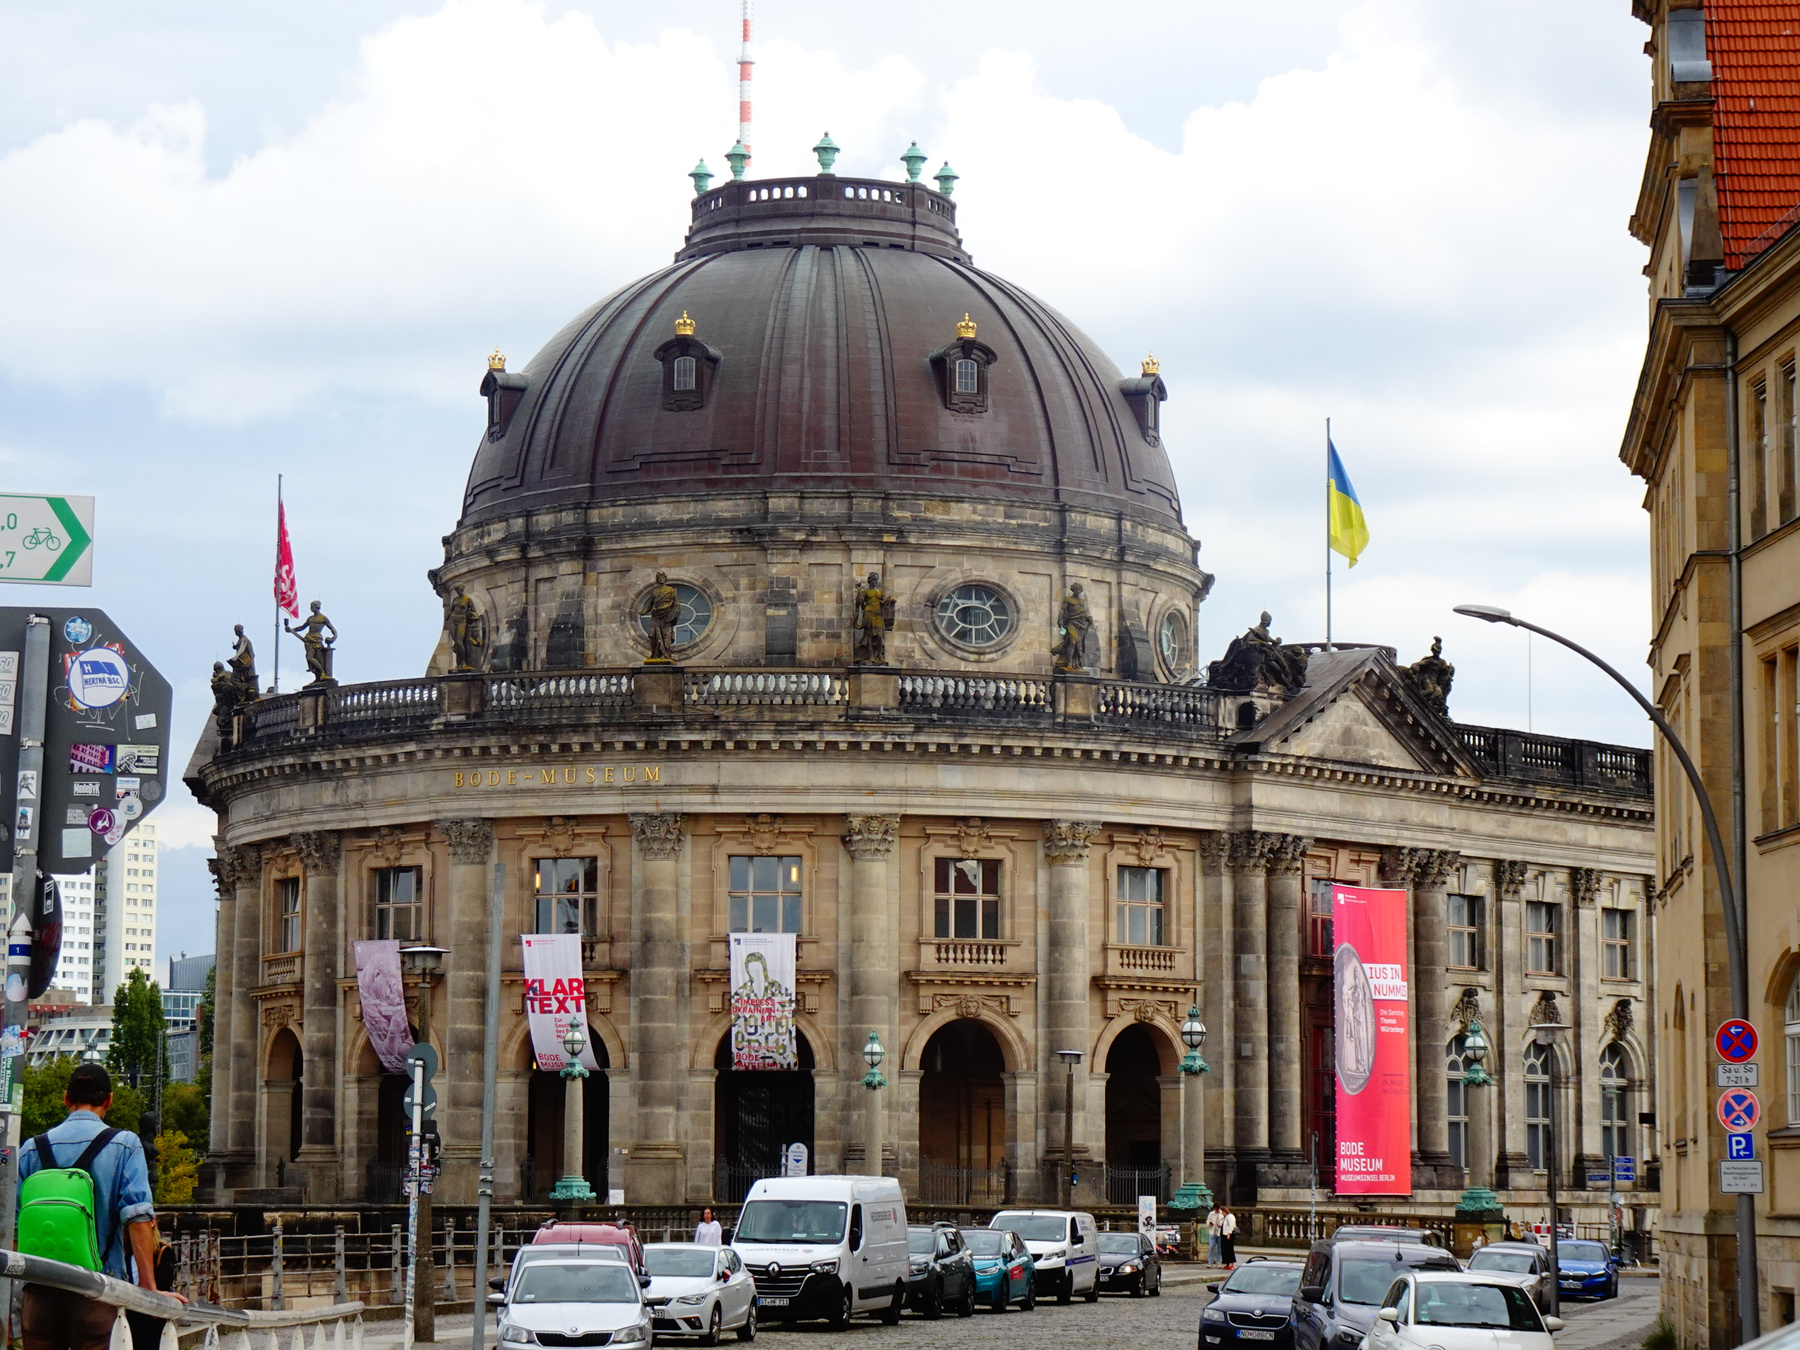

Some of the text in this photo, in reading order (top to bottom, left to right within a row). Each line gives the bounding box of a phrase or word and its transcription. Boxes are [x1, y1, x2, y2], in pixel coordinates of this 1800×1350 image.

[84, 676, 107, 686] HERTHA
[455, 766, 661, 788] BODE-MUSEUM
[1369, 967, 1400, 980] IUS IN
[525, 978, 584, 996] KLAR
[1373, 983, 1407, 997] NUMMIS
[526, 995, 585, 1014] TEXT
[736, 998, 776, 1007] TIMELESS
[732, 1006, 776, 1014] UKRAINIAN
[538, 1053, 561, 1062] BODE
[735, 1052, 760, 1061] BODE
[734, 1061, 779, 1069] MUSEUM
[1722, 1066, 1732, 1074] Sa
[1743, 1065, 1753, 1073] So
[1726, 1076, 1750, 1084] 7-21 h
[1340, 1142, 1364, 1155] BODE
[1340, 1158, 1383, 1171] MUSEUM
[1379, 1174, 1395, 1182] BERLIN
